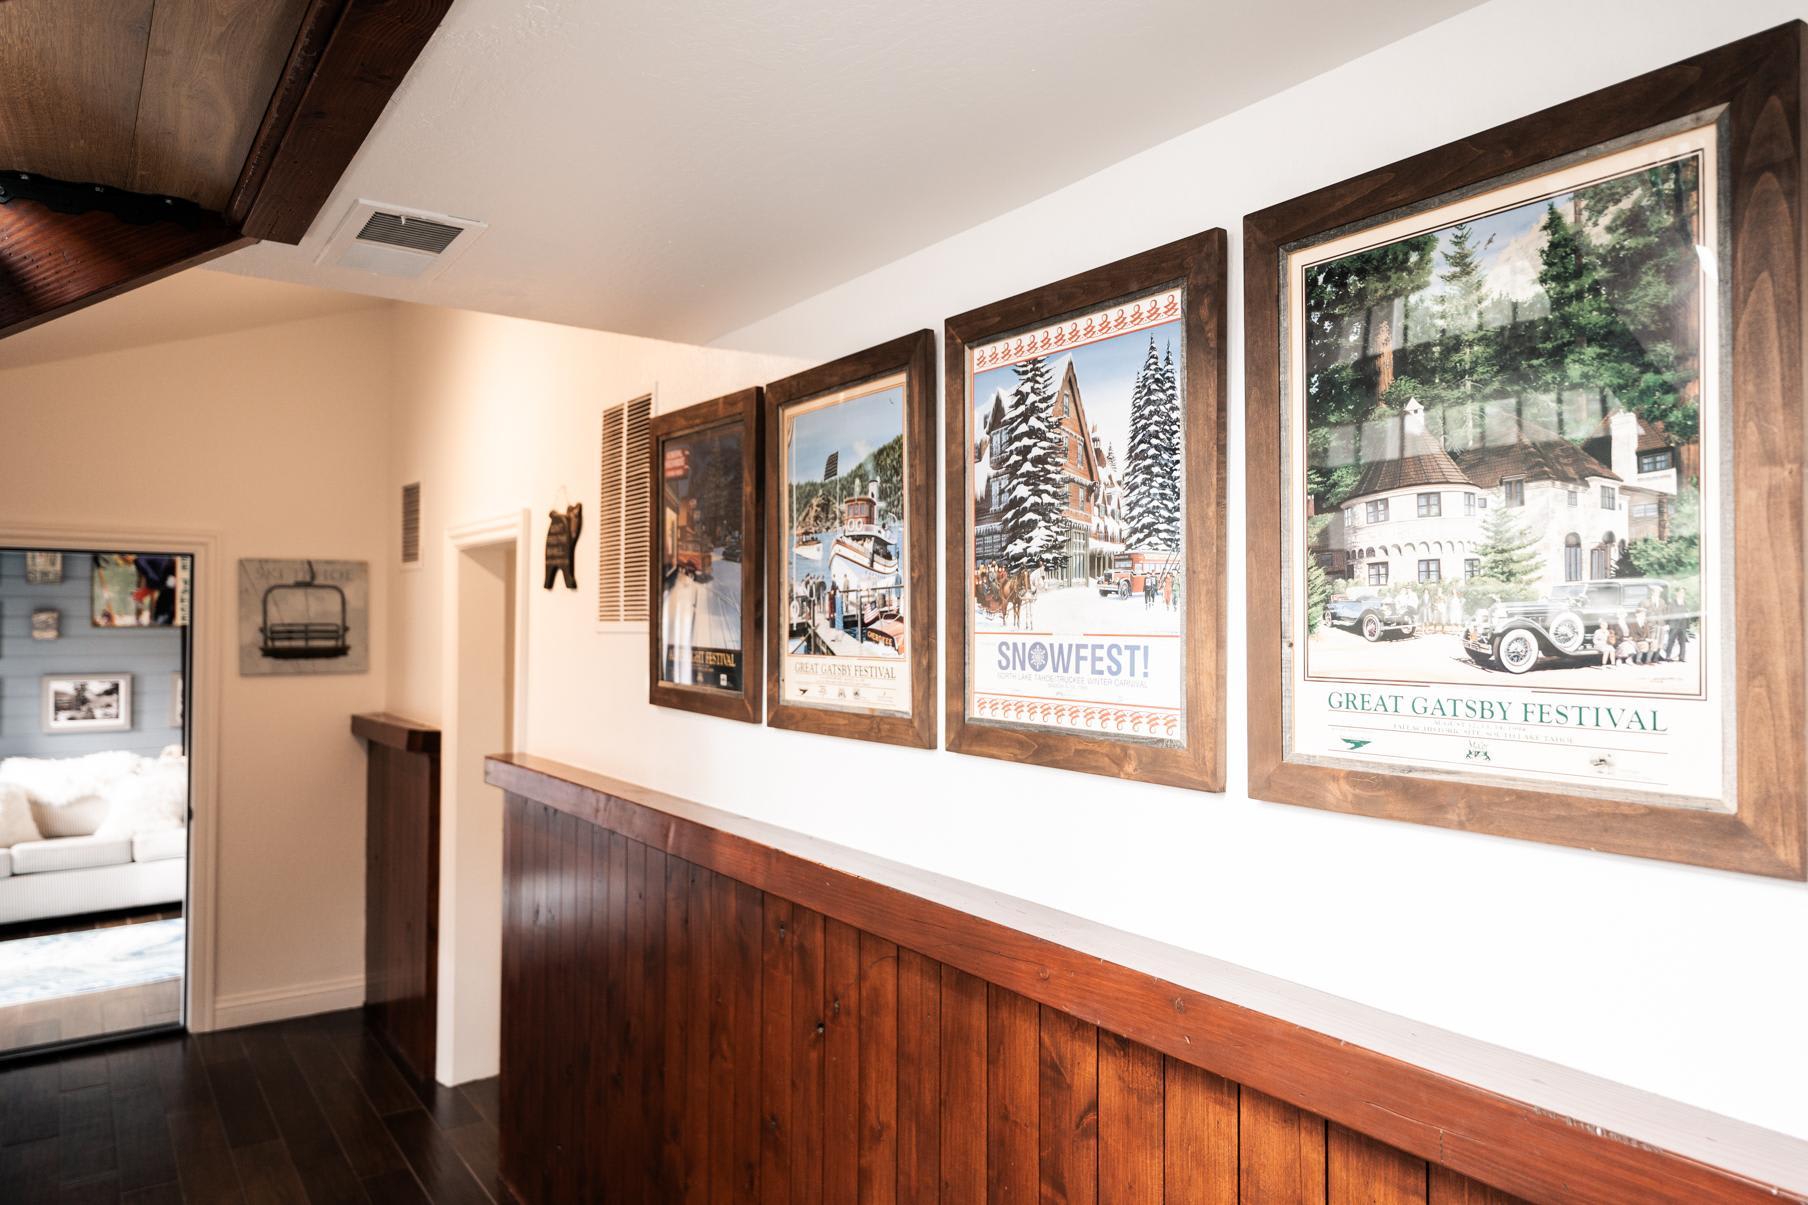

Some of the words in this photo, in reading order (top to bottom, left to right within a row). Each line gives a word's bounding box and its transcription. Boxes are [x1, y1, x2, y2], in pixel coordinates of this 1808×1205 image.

[794, 662, 819, 673] GREAT
[821, 663, 853, 677] GATSBY
[854, 664, 896, 679] FESTIVAL
[997, 641, 1149, 678] SNOWFEST!
[1327, 690, 1405, 715] GREAT
[1411, 694, 1513, 722] GATSBY
[1522, 703, 1668, 733] FESTIVAL
